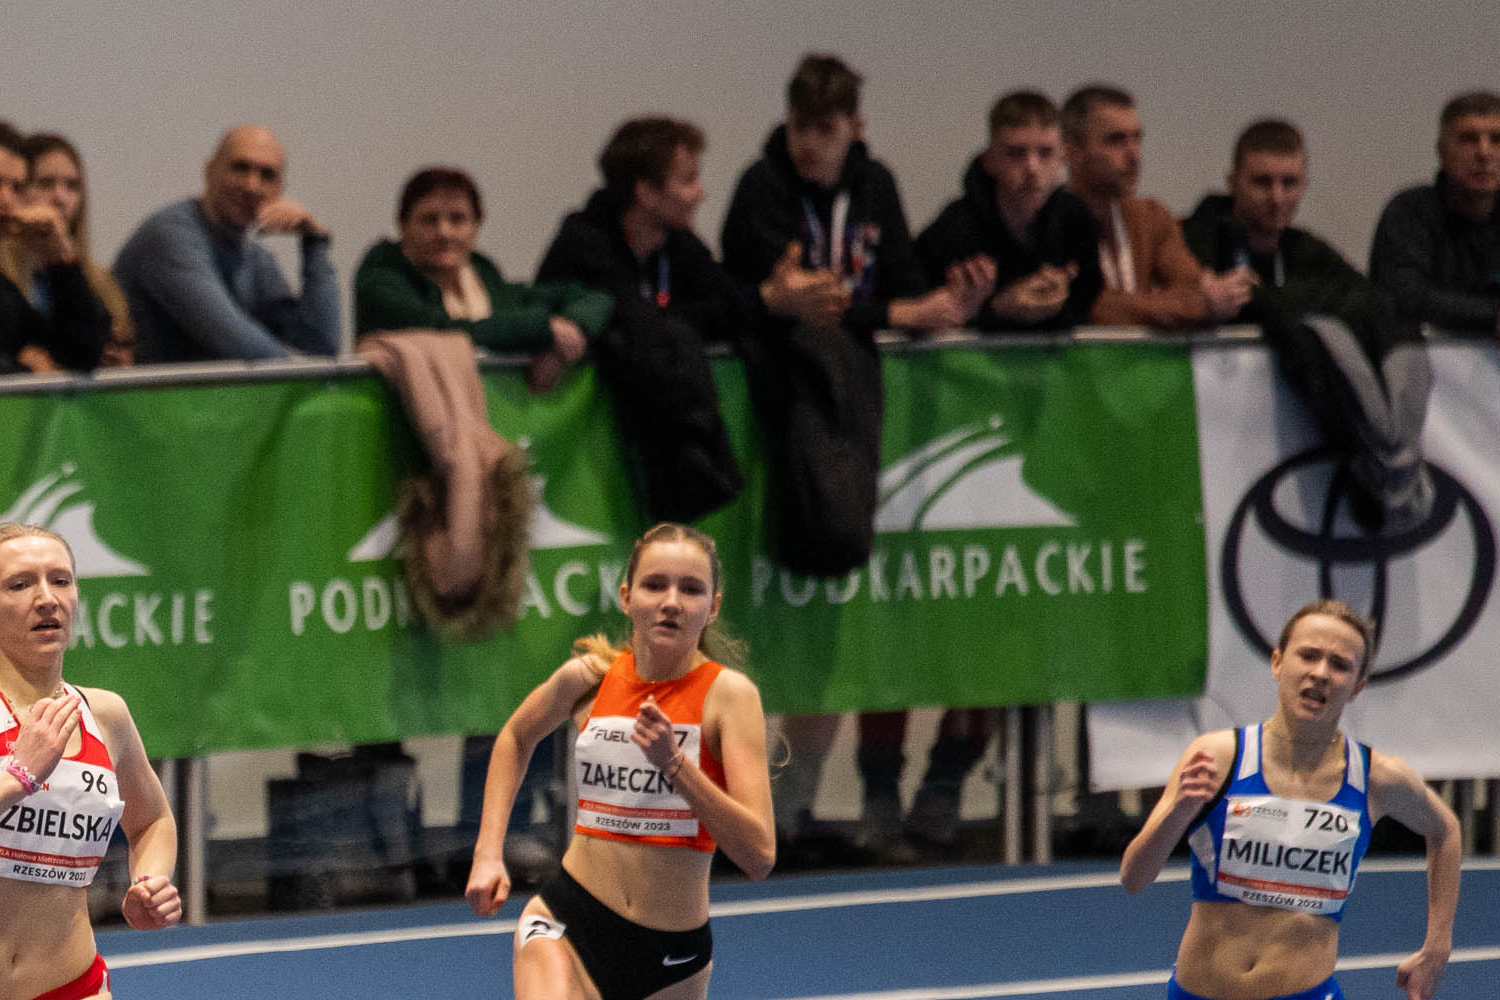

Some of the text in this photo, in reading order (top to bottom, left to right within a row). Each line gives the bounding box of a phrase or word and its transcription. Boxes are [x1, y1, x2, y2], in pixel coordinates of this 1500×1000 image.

[594, 728, 629, 744] FUEL
[81, 770, 108, 795] 96
[596, 816, 671, 832] RZESZÓW 2023
[1304, 808, 1349, 833] 720
[1226, 838, 1350, 876] MILICZEK
[13, 864, 67, 881] RZESZÓW
[1297, 898, 1324, 909] 2023
